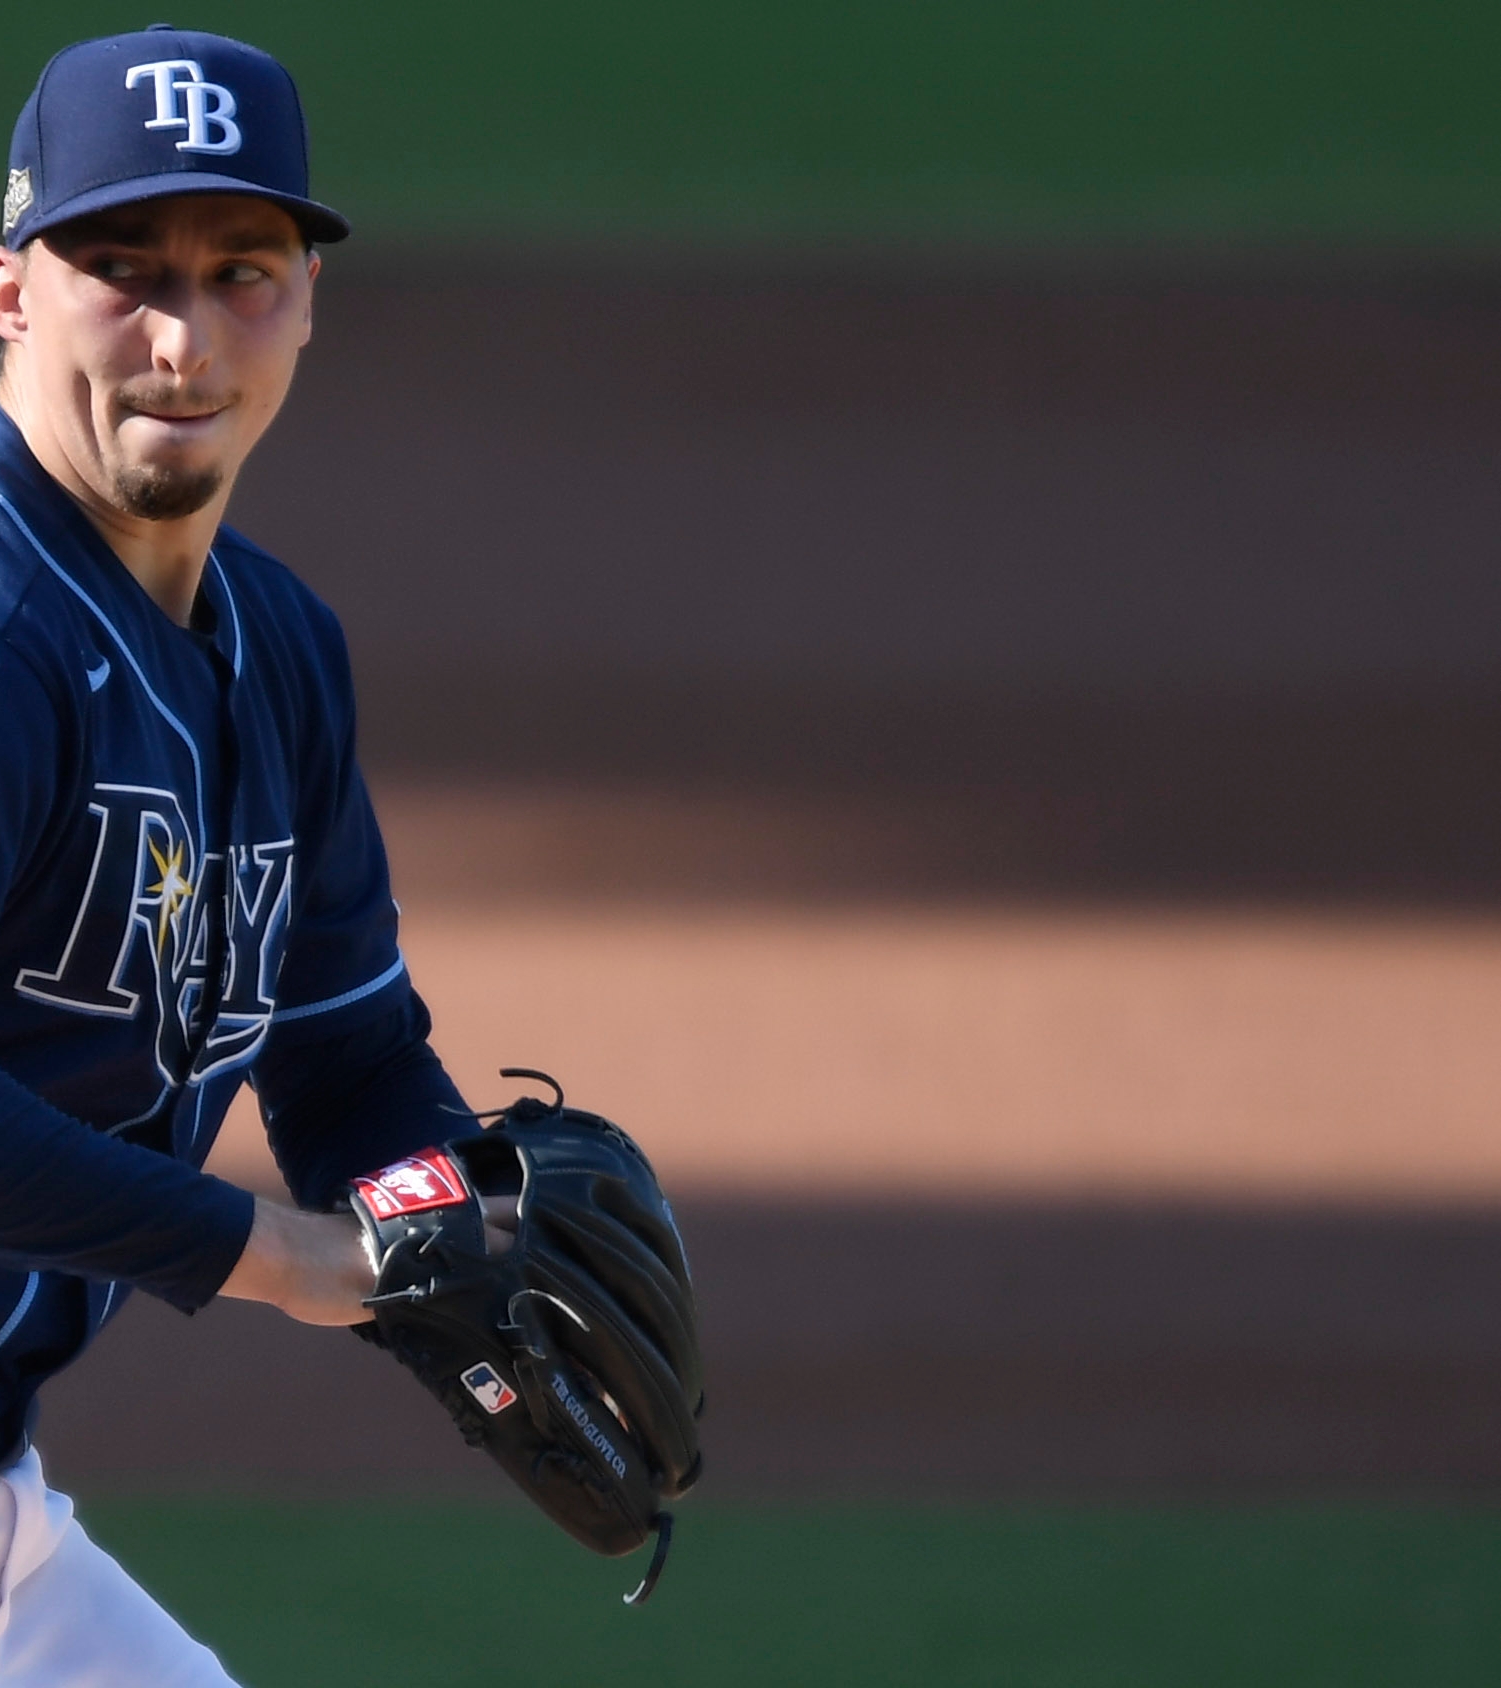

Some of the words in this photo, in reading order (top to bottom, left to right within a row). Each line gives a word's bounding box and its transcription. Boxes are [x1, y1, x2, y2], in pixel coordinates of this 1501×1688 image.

[125, 59, 242, 156] TB
[13, 776, 297, 1086] RAY
[565, 1394, 589, 1429] GOLD
[583, 1422, 616, 1462] GLOVE
[612, 1455, 626, 1479] CO.
